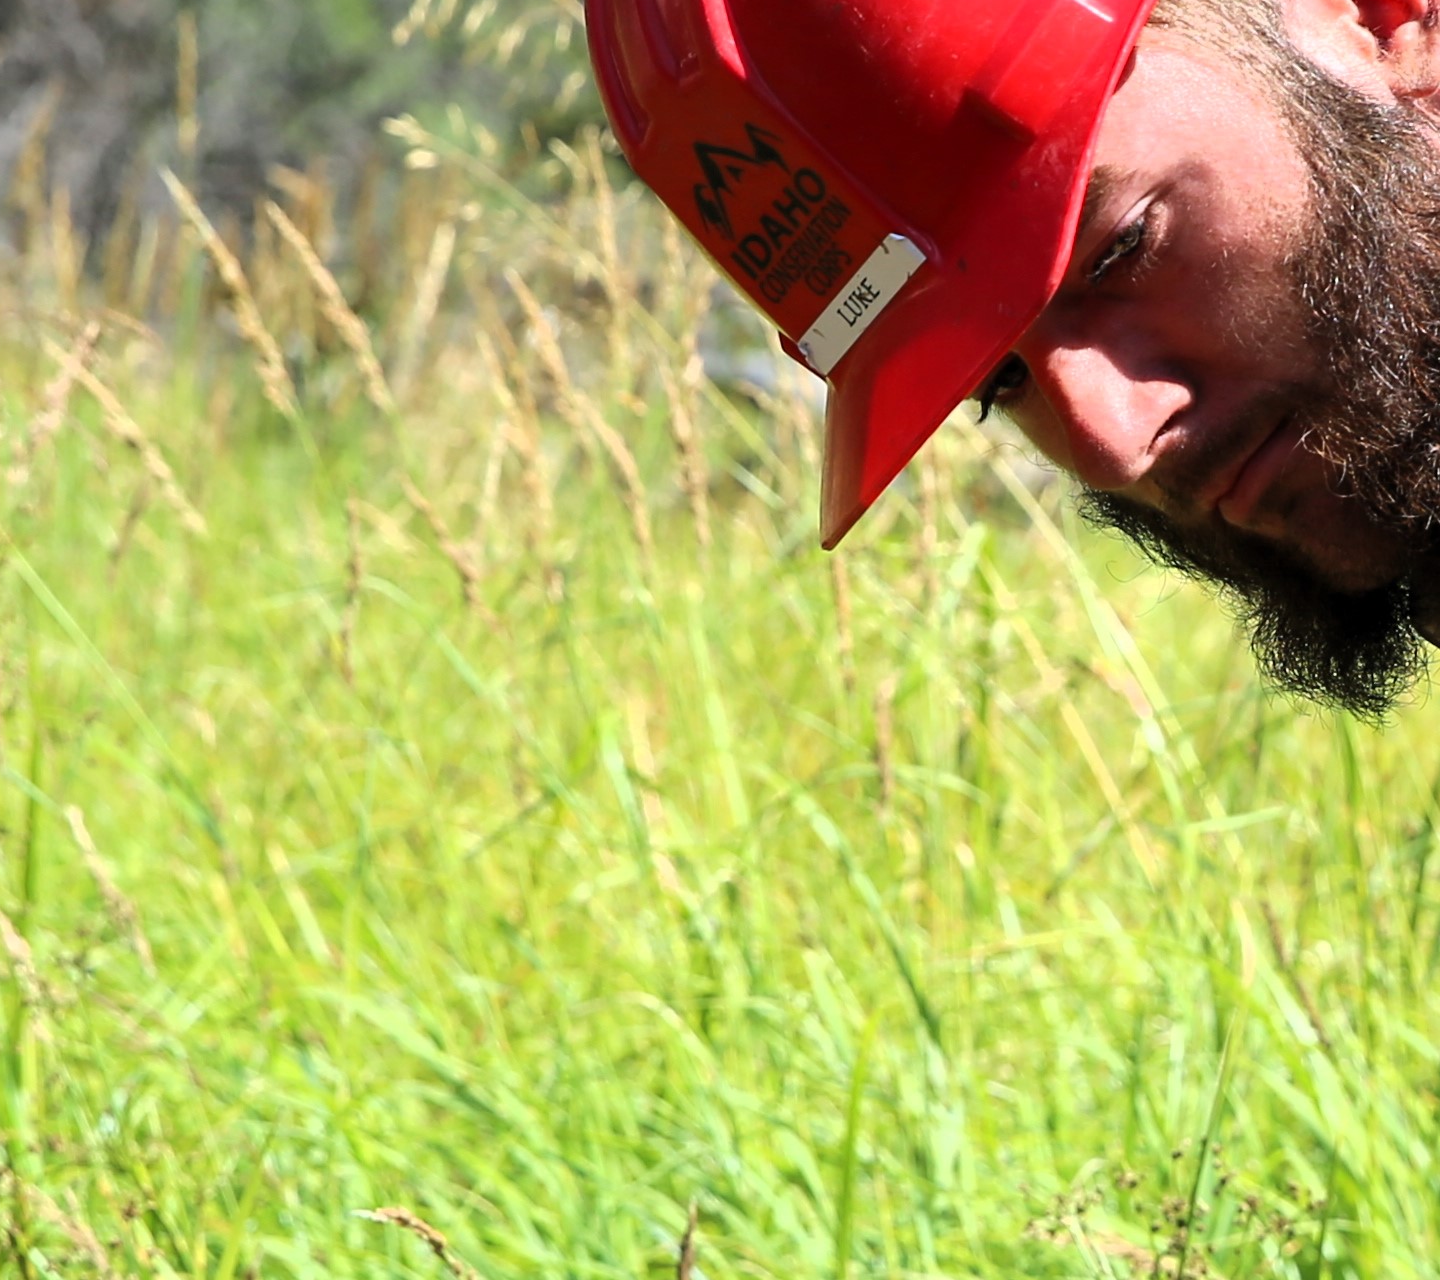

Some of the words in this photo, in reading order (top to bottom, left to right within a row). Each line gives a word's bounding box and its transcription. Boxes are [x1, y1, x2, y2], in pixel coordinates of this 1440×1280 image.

[732, 167, 826, 280] IDAHO
[760, 196, 853, 304] CONSERVATION
[804, 245, 852, 297] CORPS
[837, 276, 880, 327] LUKE
